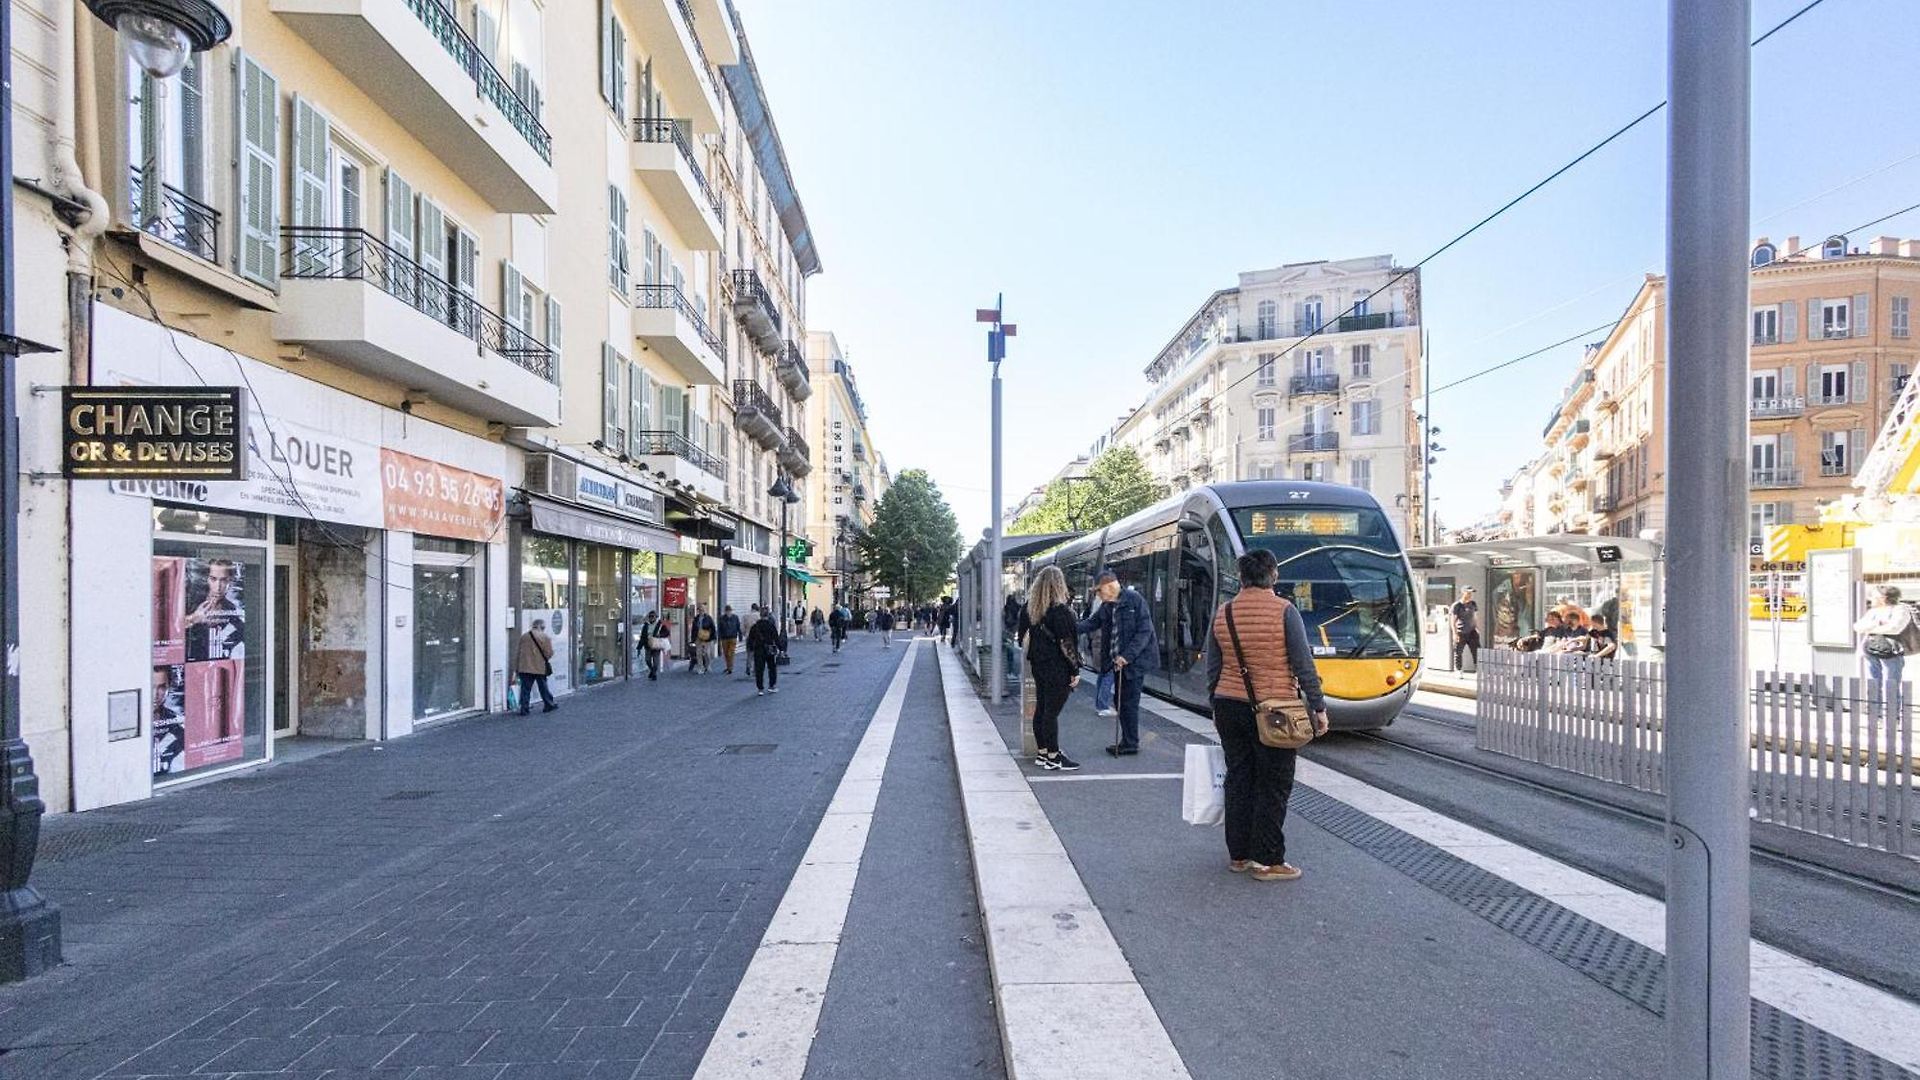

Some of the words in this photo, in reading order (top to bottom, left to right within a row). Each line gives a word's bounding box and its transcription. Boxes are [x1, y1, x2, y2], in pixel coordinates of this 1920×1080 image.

[70, 404, 234, 436] CHANGE
[70, 441, 107, 462] OR
[112, 441, 131, 462] &
[137, 441, 234, 462] DEVISES
[270, 432, 353, 479] LOUER
[386, 463, 409, 491] 04
[414, 470, 435, 497] 93
[440, 476, 458, 502] 55
[463, 483, 480, 506] 26
[1288, 491, 1310, 499] 27
